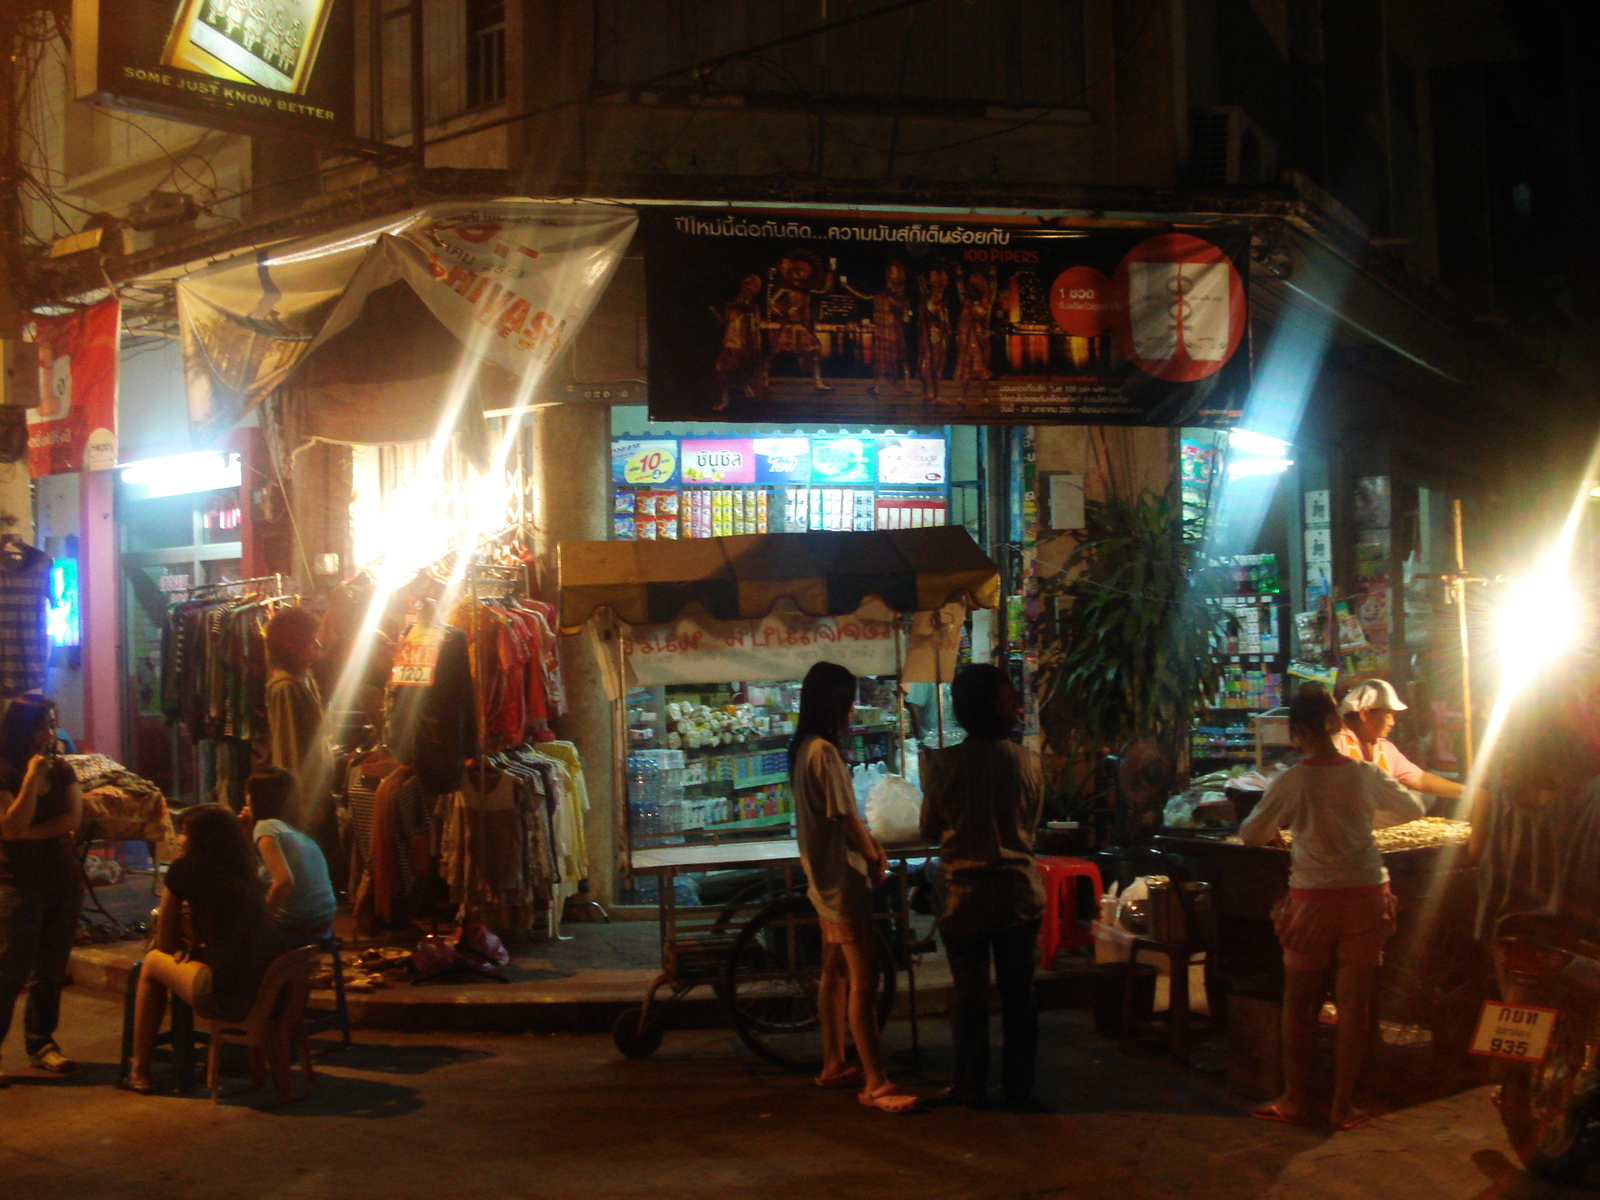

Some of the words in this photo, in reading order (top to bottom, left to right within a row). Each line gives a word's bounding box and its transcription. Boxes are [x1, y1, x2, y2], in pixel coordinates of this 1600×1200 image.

[124, 66, 172, 86] SOME
[177, 77, 220, 97] JUST
[223, 86, 272, 107] KNOW
[277, 100, 335, 121] BETTER
[639, 452, 662, 473] 10
[1488, 1037, 1530, 1056] 935
